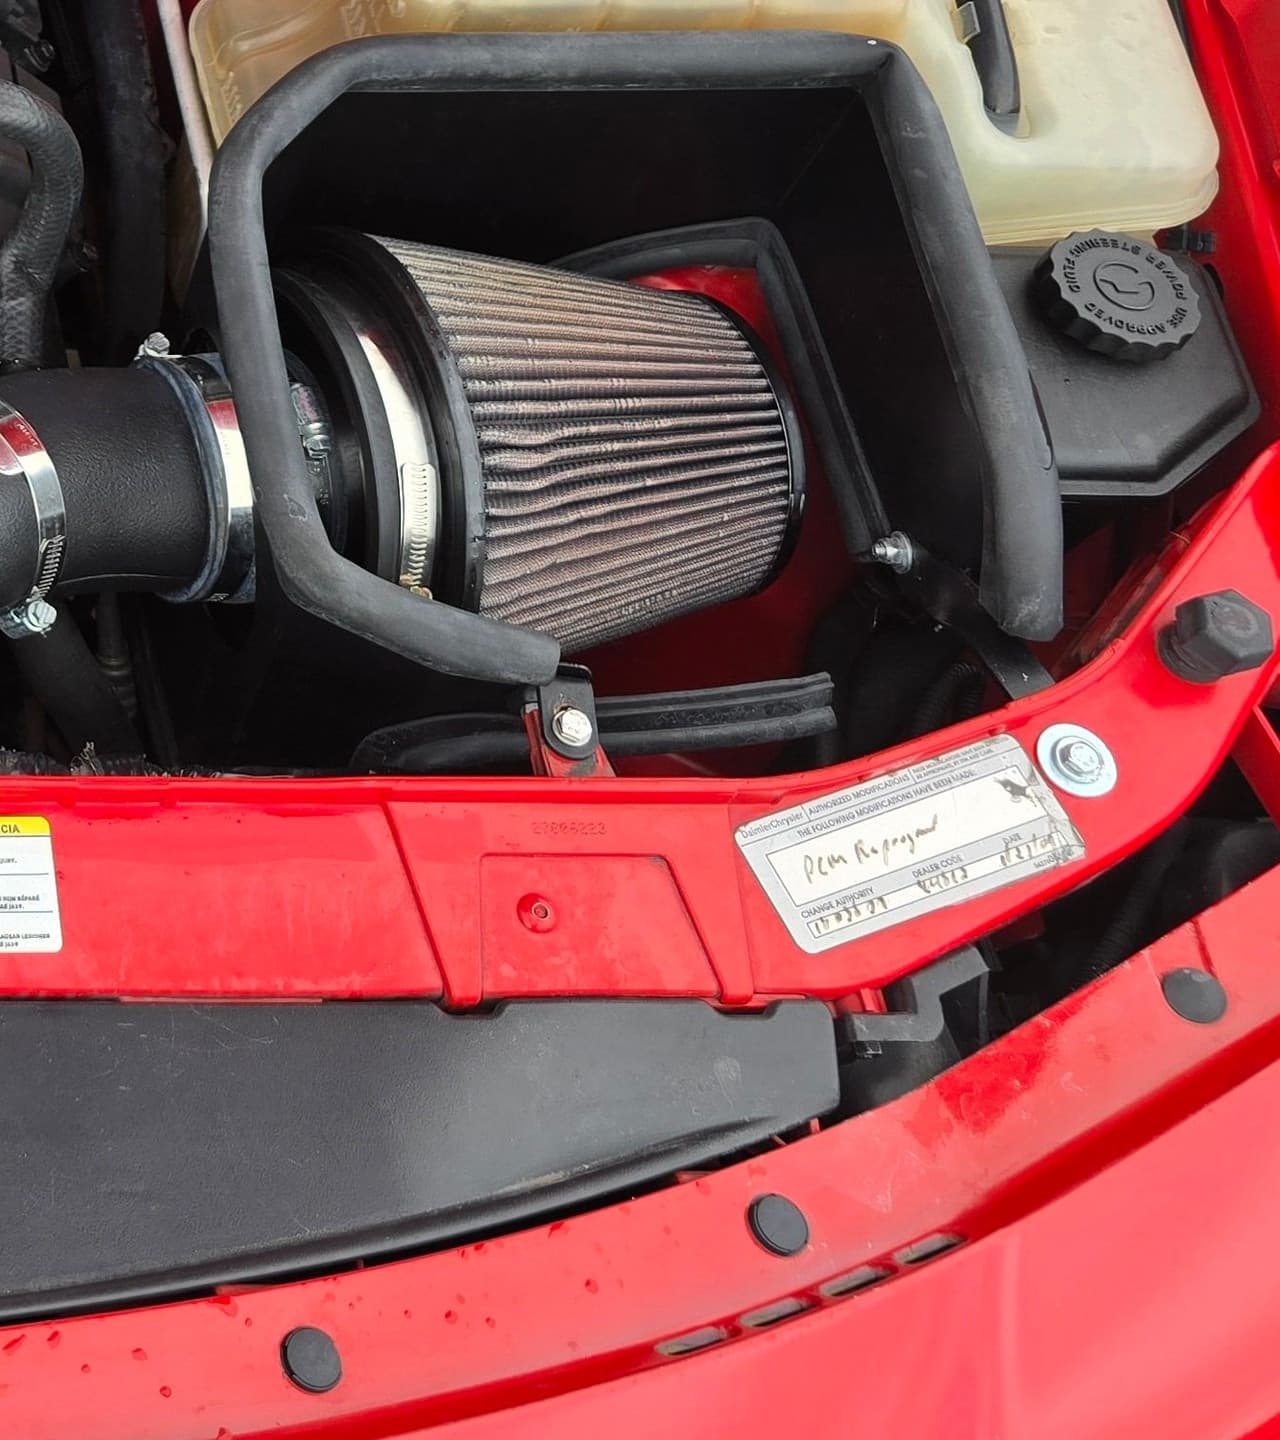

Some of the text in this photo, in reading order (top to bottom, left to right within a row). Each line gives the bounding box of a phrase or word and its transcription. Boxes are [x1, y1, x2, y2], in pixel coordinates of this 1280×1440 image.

[1070, 237, 1142, 259] STEERING
[1145, 252, 1188, 301] POWER
[1083, 301, 1188, 336] USE APPROVED
[807, 773, 911, 817] AUTHORIZED MODIFICATIONS
[800, 898, 834, 919] CHANGE
[833, 883, 874, 906] AUTHORITY
